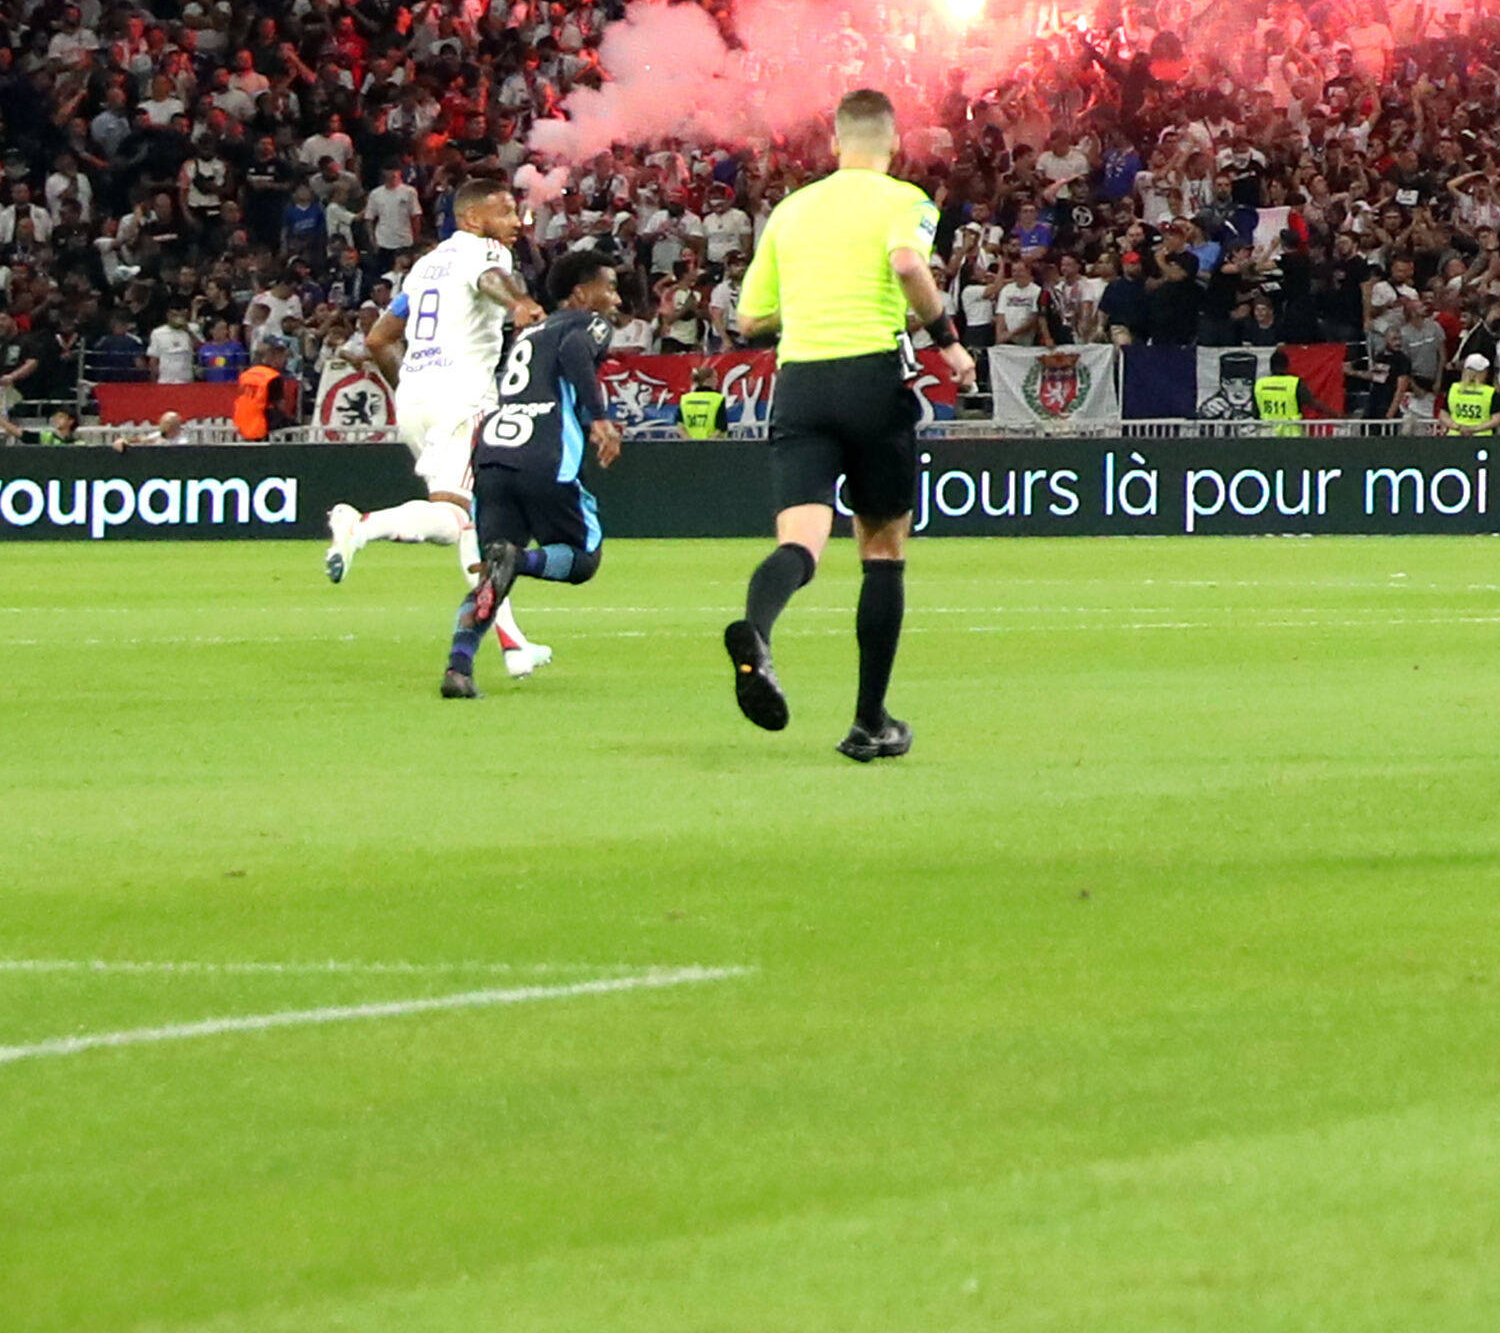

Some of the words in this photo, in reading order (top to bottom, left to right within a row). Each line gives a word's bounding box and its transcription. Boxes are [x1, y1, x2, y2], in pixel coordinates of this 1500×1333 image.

[415, 288, 441, 341] 8
[500, 338, 533, 396] 8
[0, 476, 298, 538] oupama
[1104, 451, 1158, 516] là
[1185, 467, 1341, 532] pour
[1365, 449, 1488, 515] moi
